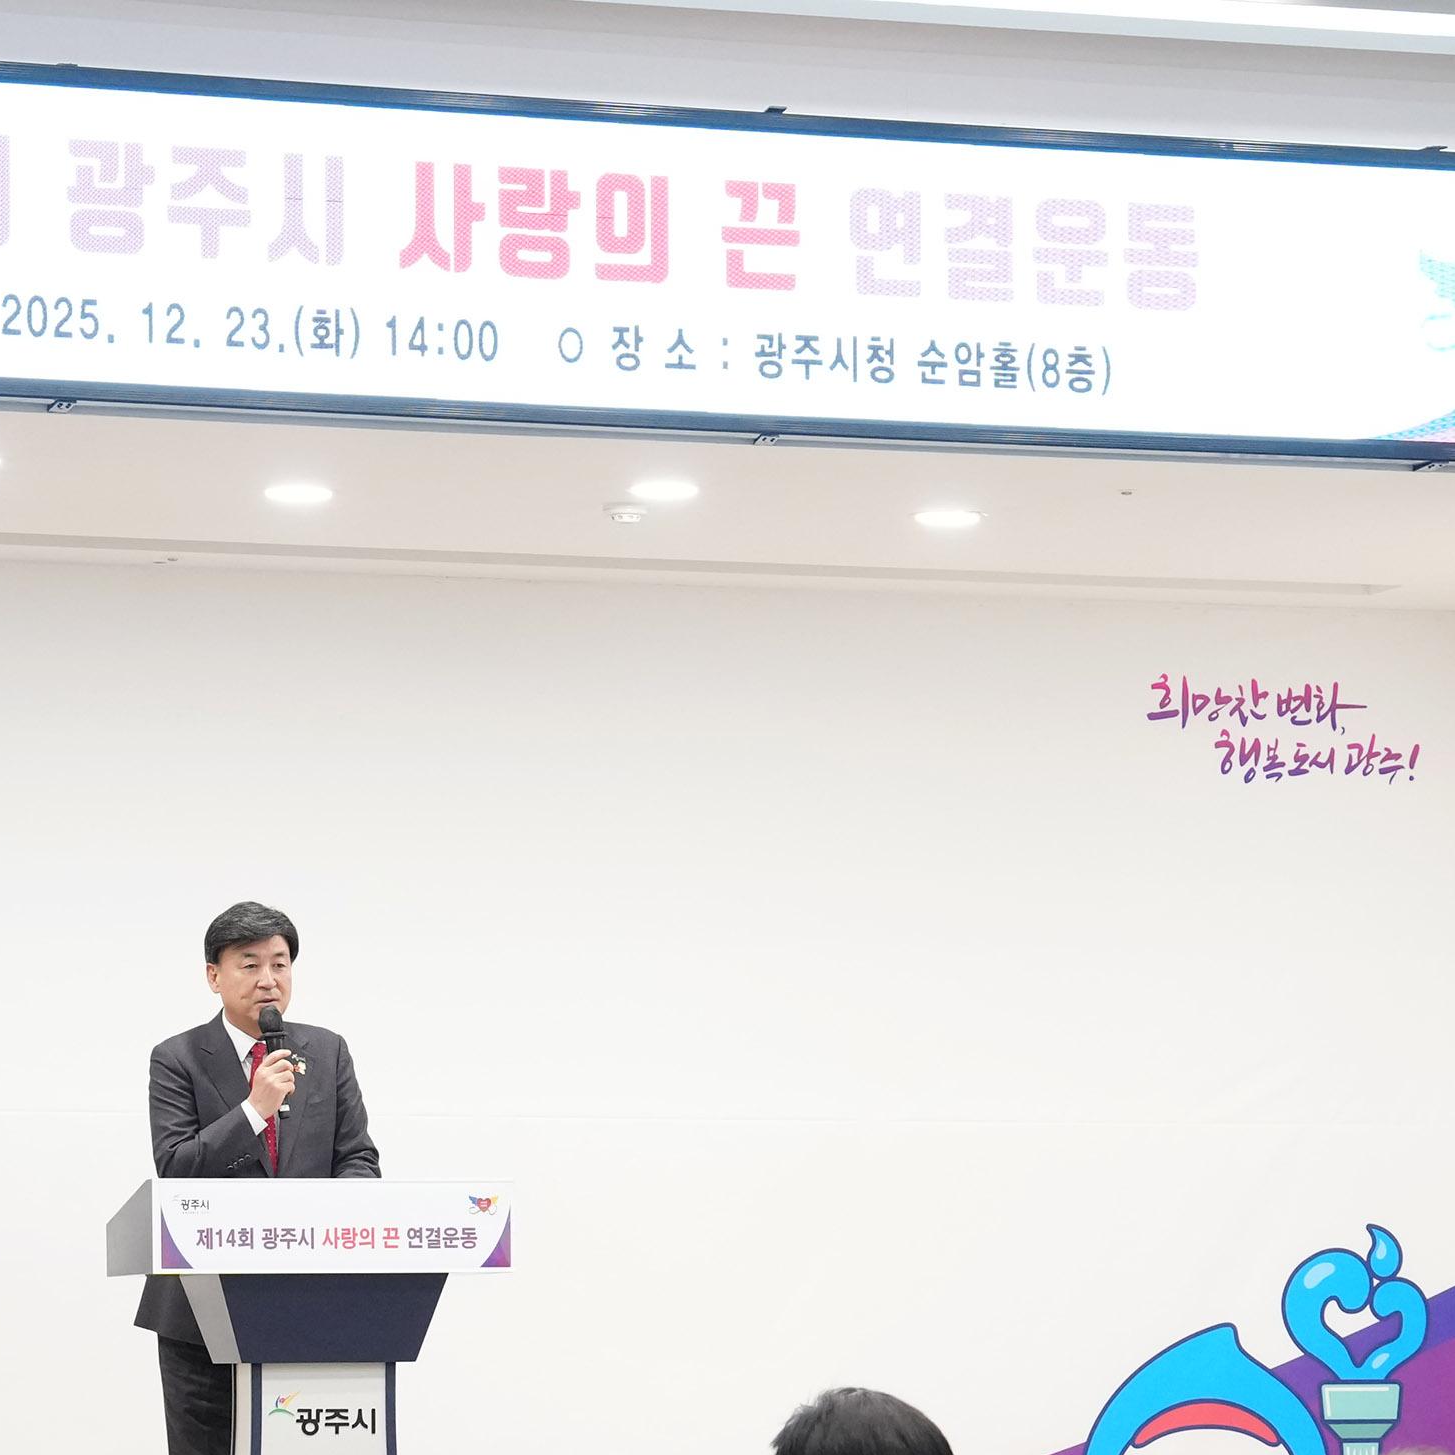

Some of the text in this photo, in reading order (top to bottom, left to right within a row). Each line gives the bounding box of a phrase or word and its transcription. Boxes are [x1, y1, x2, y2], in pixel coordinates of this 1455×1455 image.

[66, 139, 344, 266] 광주시
[399, 161, 669, 284] 사랑의
[721, 180, 800, 291] 끈
[850, 187, 1199, 311] 연결운동
[1, 294, 115, 343] 2025.
[142, 302, 200, 348] 12.
[226, 305, 359, 359] 23.(화)
[386, 315, 498, 361] 14:00
[611, 325, 643, 371] 장
[665, 328, 696, 369] 소
[755, 332, 895, 384] 광주시청
[917, 339, 1111, 396] 순암홀(8층)
[1147, 673, 1269, 729] 희망찬
[1344, 733, 1420, 784] 광주!
[181, 1199, 210, 1210] 광주시
[196, 1227, 477, 1250] 제14회 광주시 사랑의 끈 연결운동
[296, 1408, 376, 1436] 광주시
